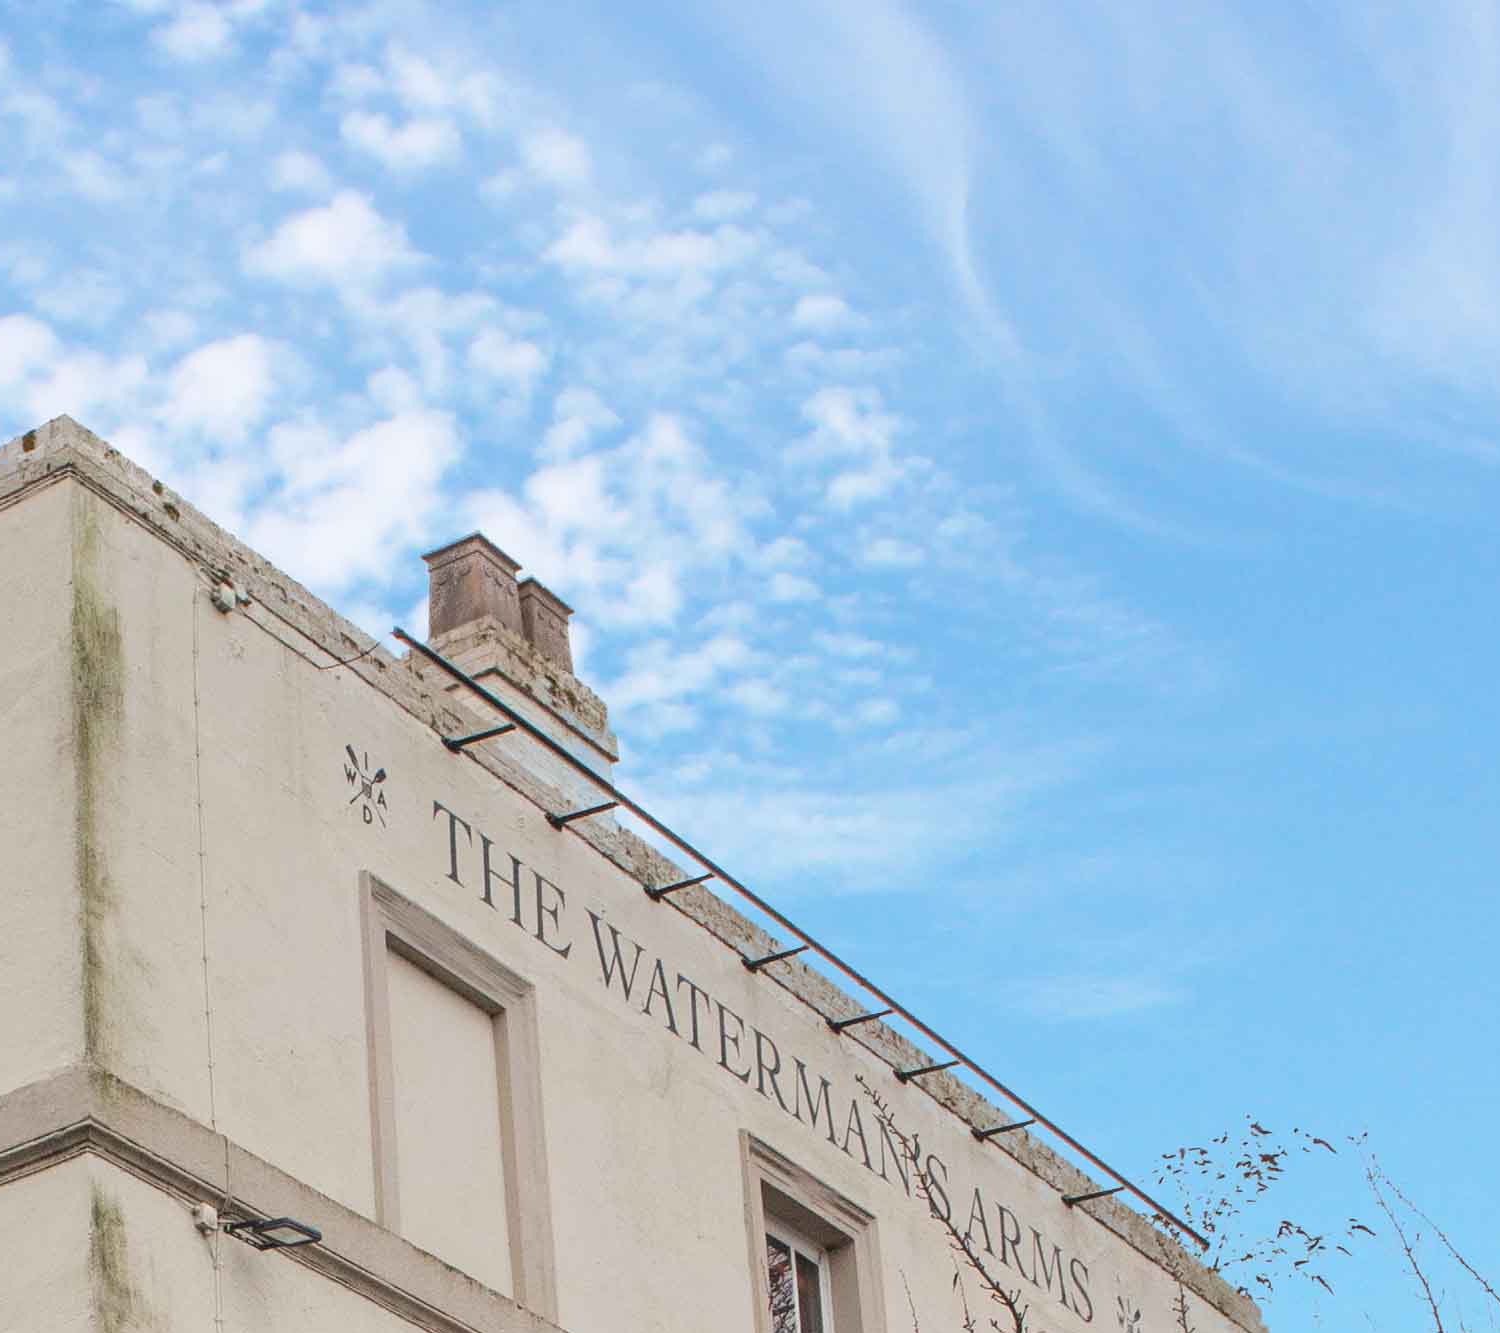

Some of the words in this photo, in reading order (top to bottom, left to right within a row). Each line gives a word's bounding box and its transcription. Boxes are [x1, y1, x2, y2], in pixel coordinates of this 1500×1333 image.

[433, 801, 572, 960] THE
[585, 908, 950, 1223] WATERMAN'S
[966, 1187, 1094, 1323] ARMS
